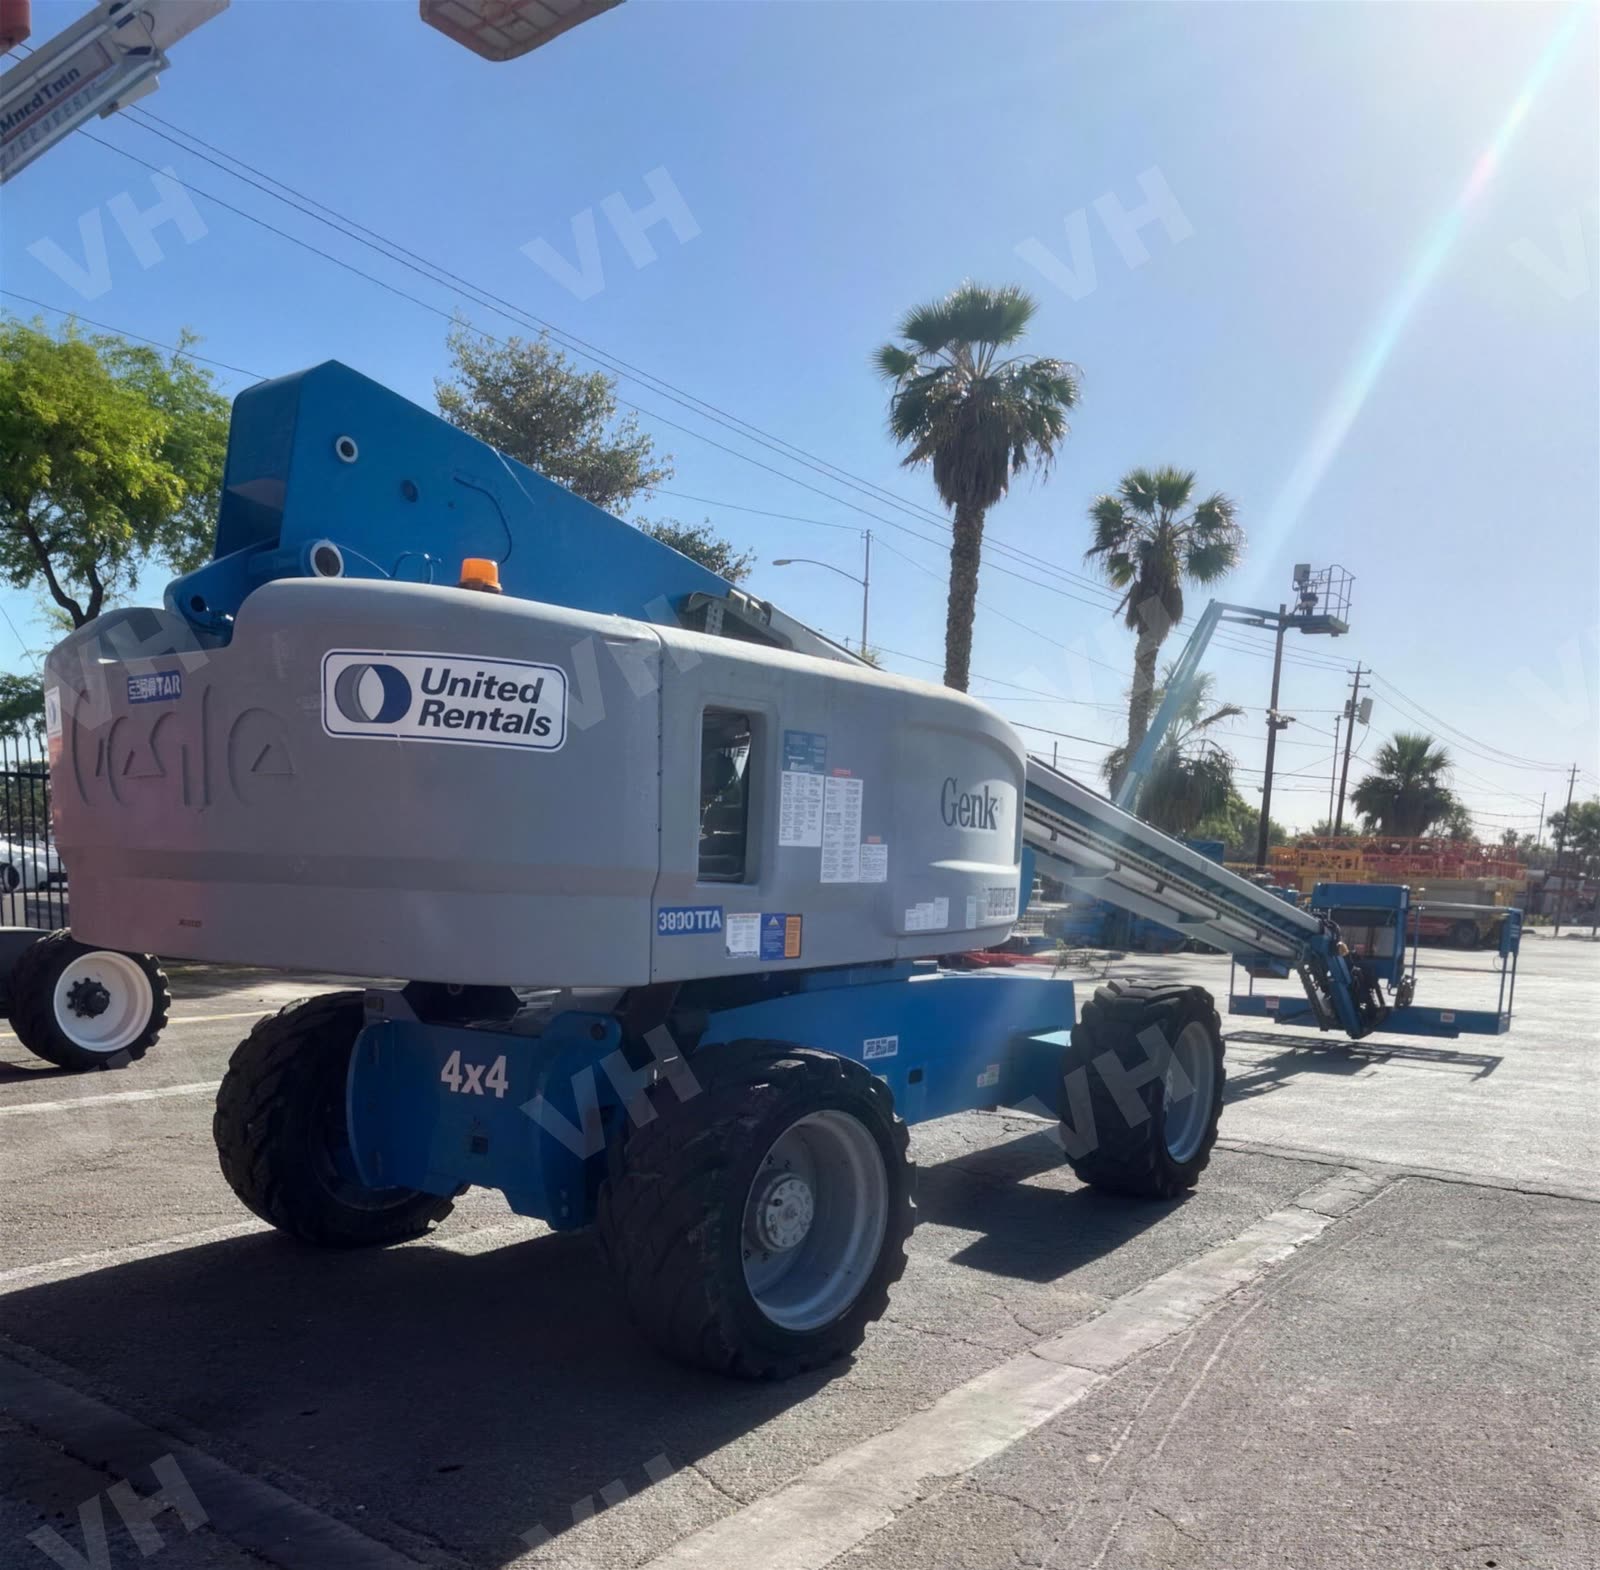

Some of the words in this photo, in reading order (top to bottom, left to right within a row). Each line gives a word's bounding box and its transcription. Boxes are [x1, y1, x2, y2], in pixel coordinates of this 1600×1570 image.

[420, 667, 544, 704] United
[418, 699, 552, 737] Rentals
[440, 1050, 509, 1098] 4x4
